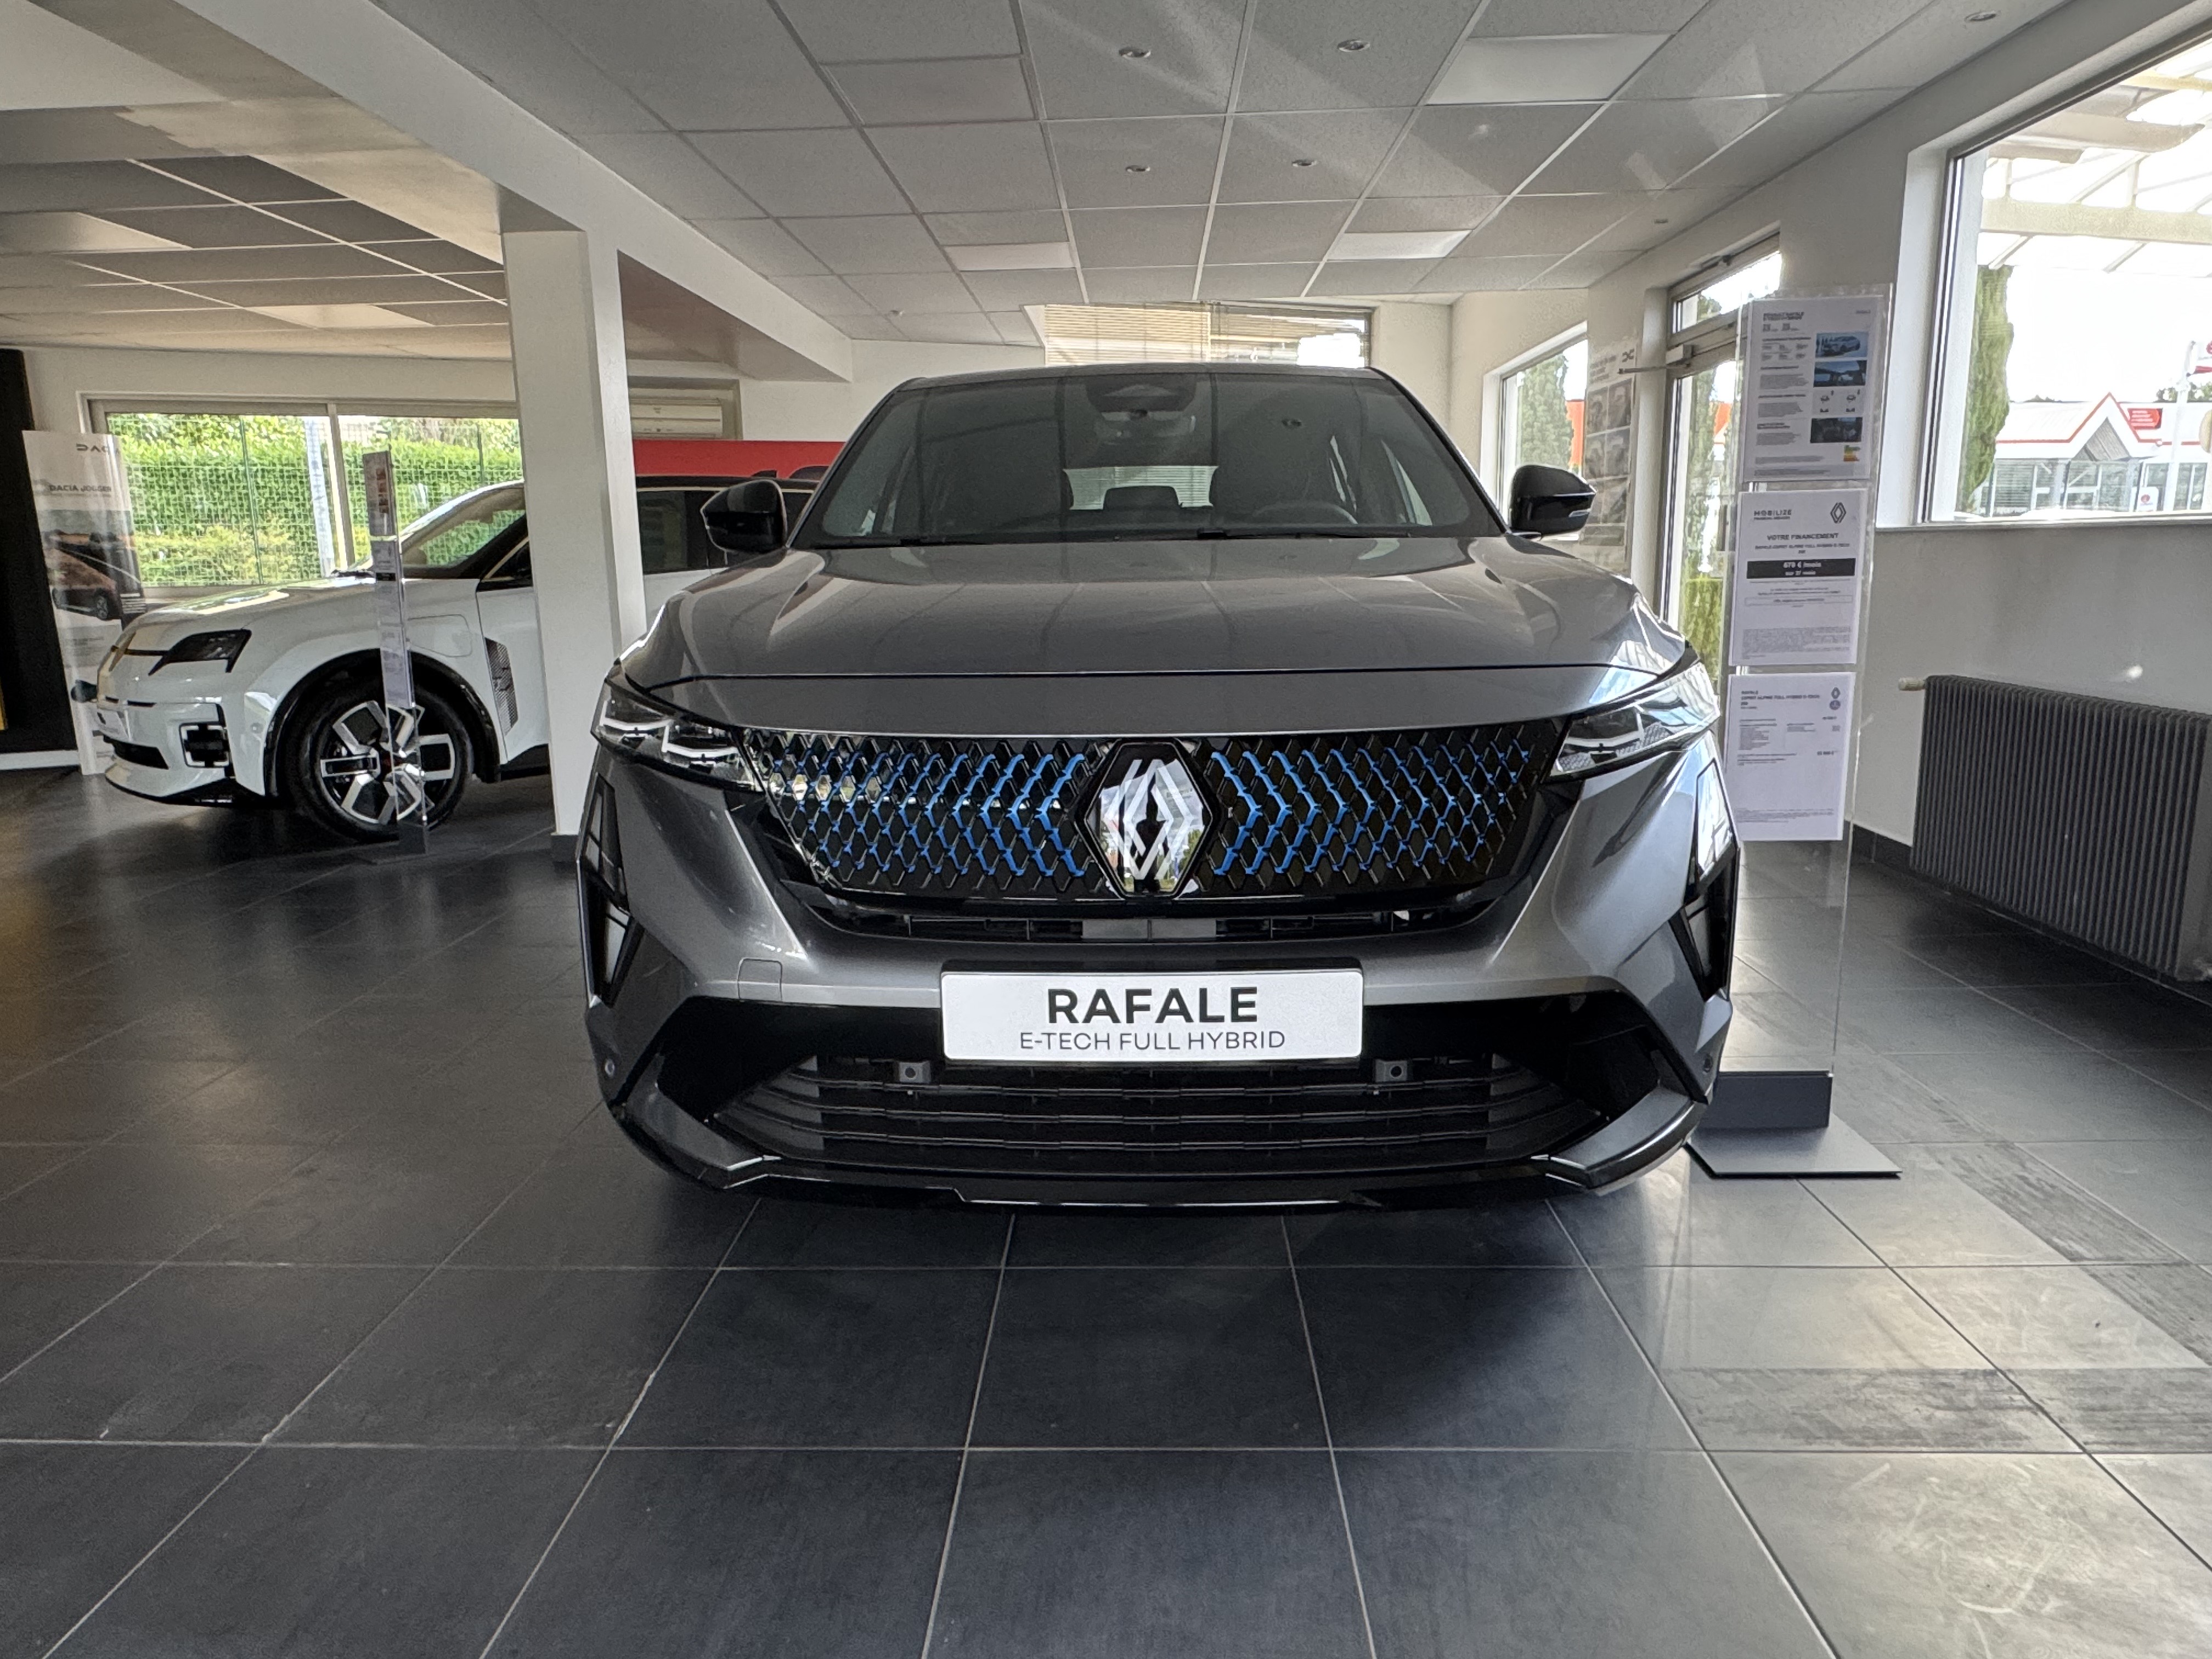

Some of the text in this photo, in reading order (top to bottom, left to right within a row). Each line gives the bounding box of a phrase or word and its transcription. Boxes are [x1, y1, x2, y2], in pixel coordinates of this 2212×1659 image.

[1047, 986, 1258, 1024] RAFALE
[1020, 1030, 1285, 1050] E-TECH FULL HYBRID
